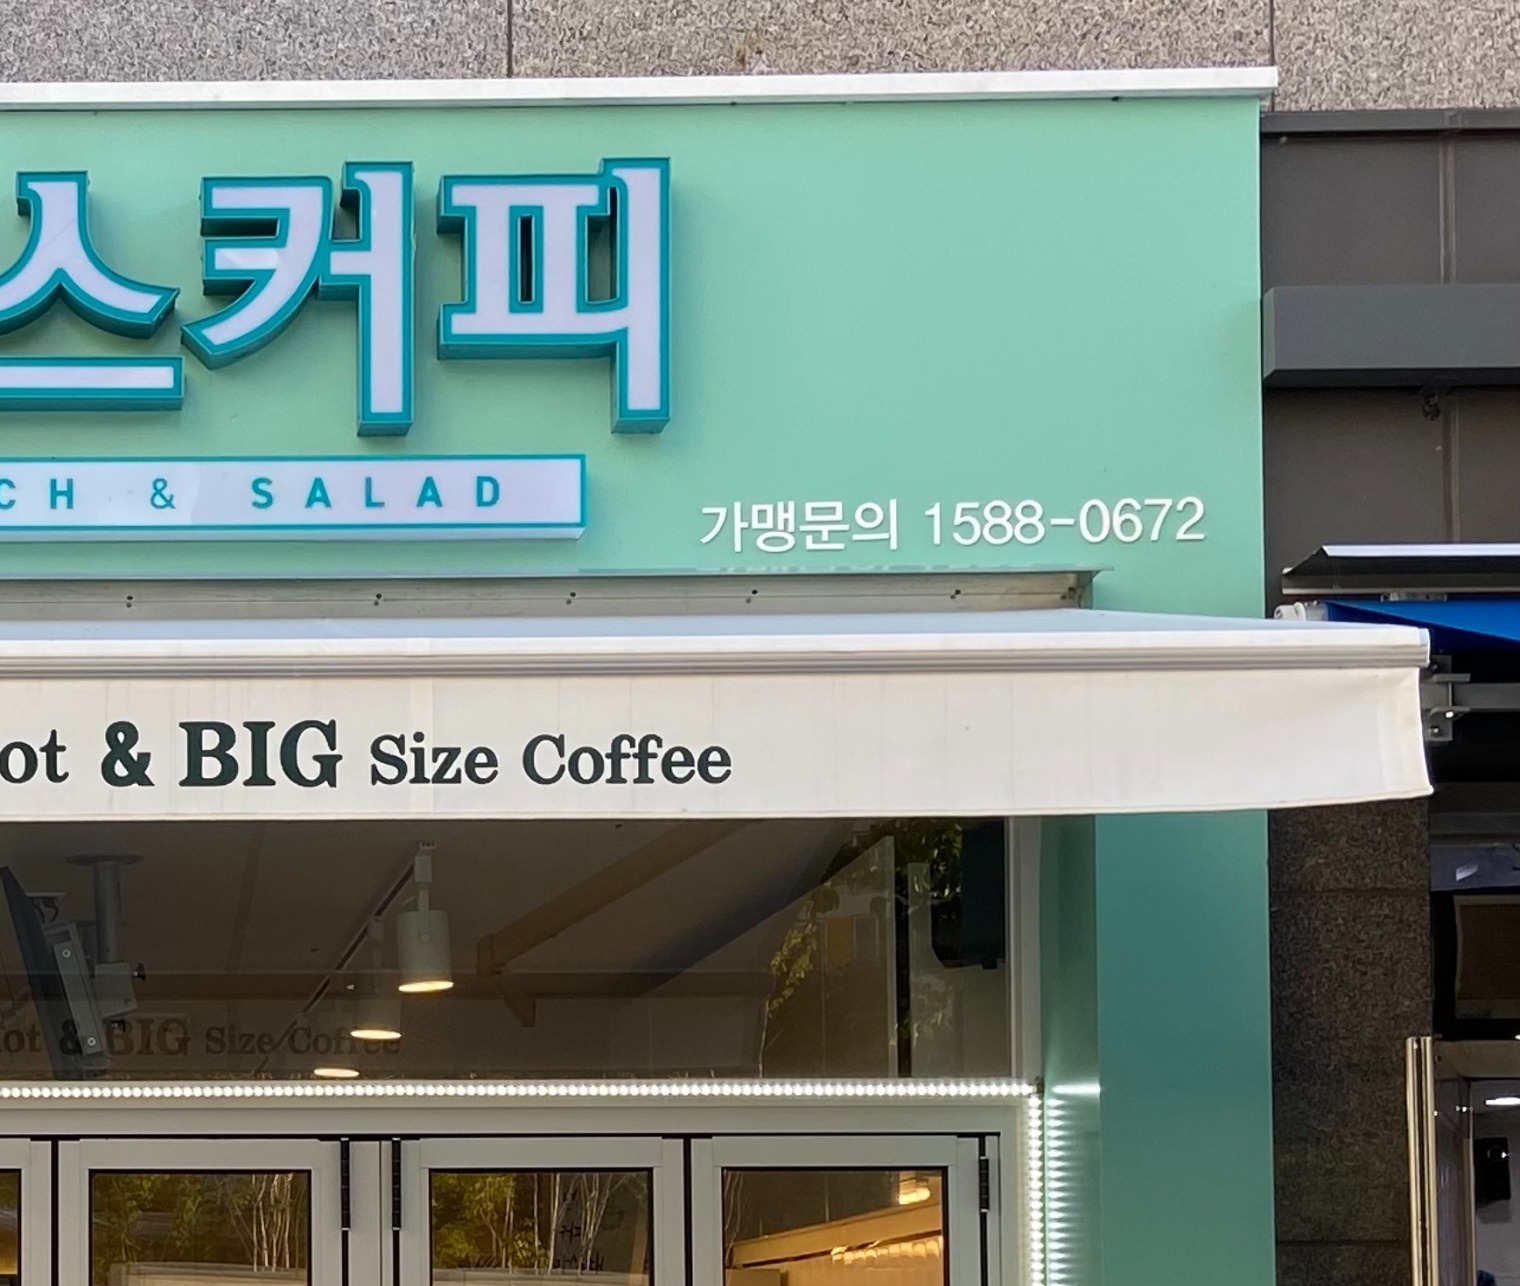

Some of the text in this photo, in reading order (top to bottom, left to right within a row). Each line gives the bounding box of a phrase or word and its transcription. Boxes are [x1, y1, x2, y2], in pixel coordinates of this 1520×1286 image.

[150, 478, 176, 510] &
[251, 475, 501, 510] SALAD
[700, 496, 1206, 553] 가맹문의 1588-0672
[100, 720, 155, 787] &
[179, 719, 344, 788] BIG
[370, 731, 498, 786] Size
[522, 733, 732, 786] Coffee
